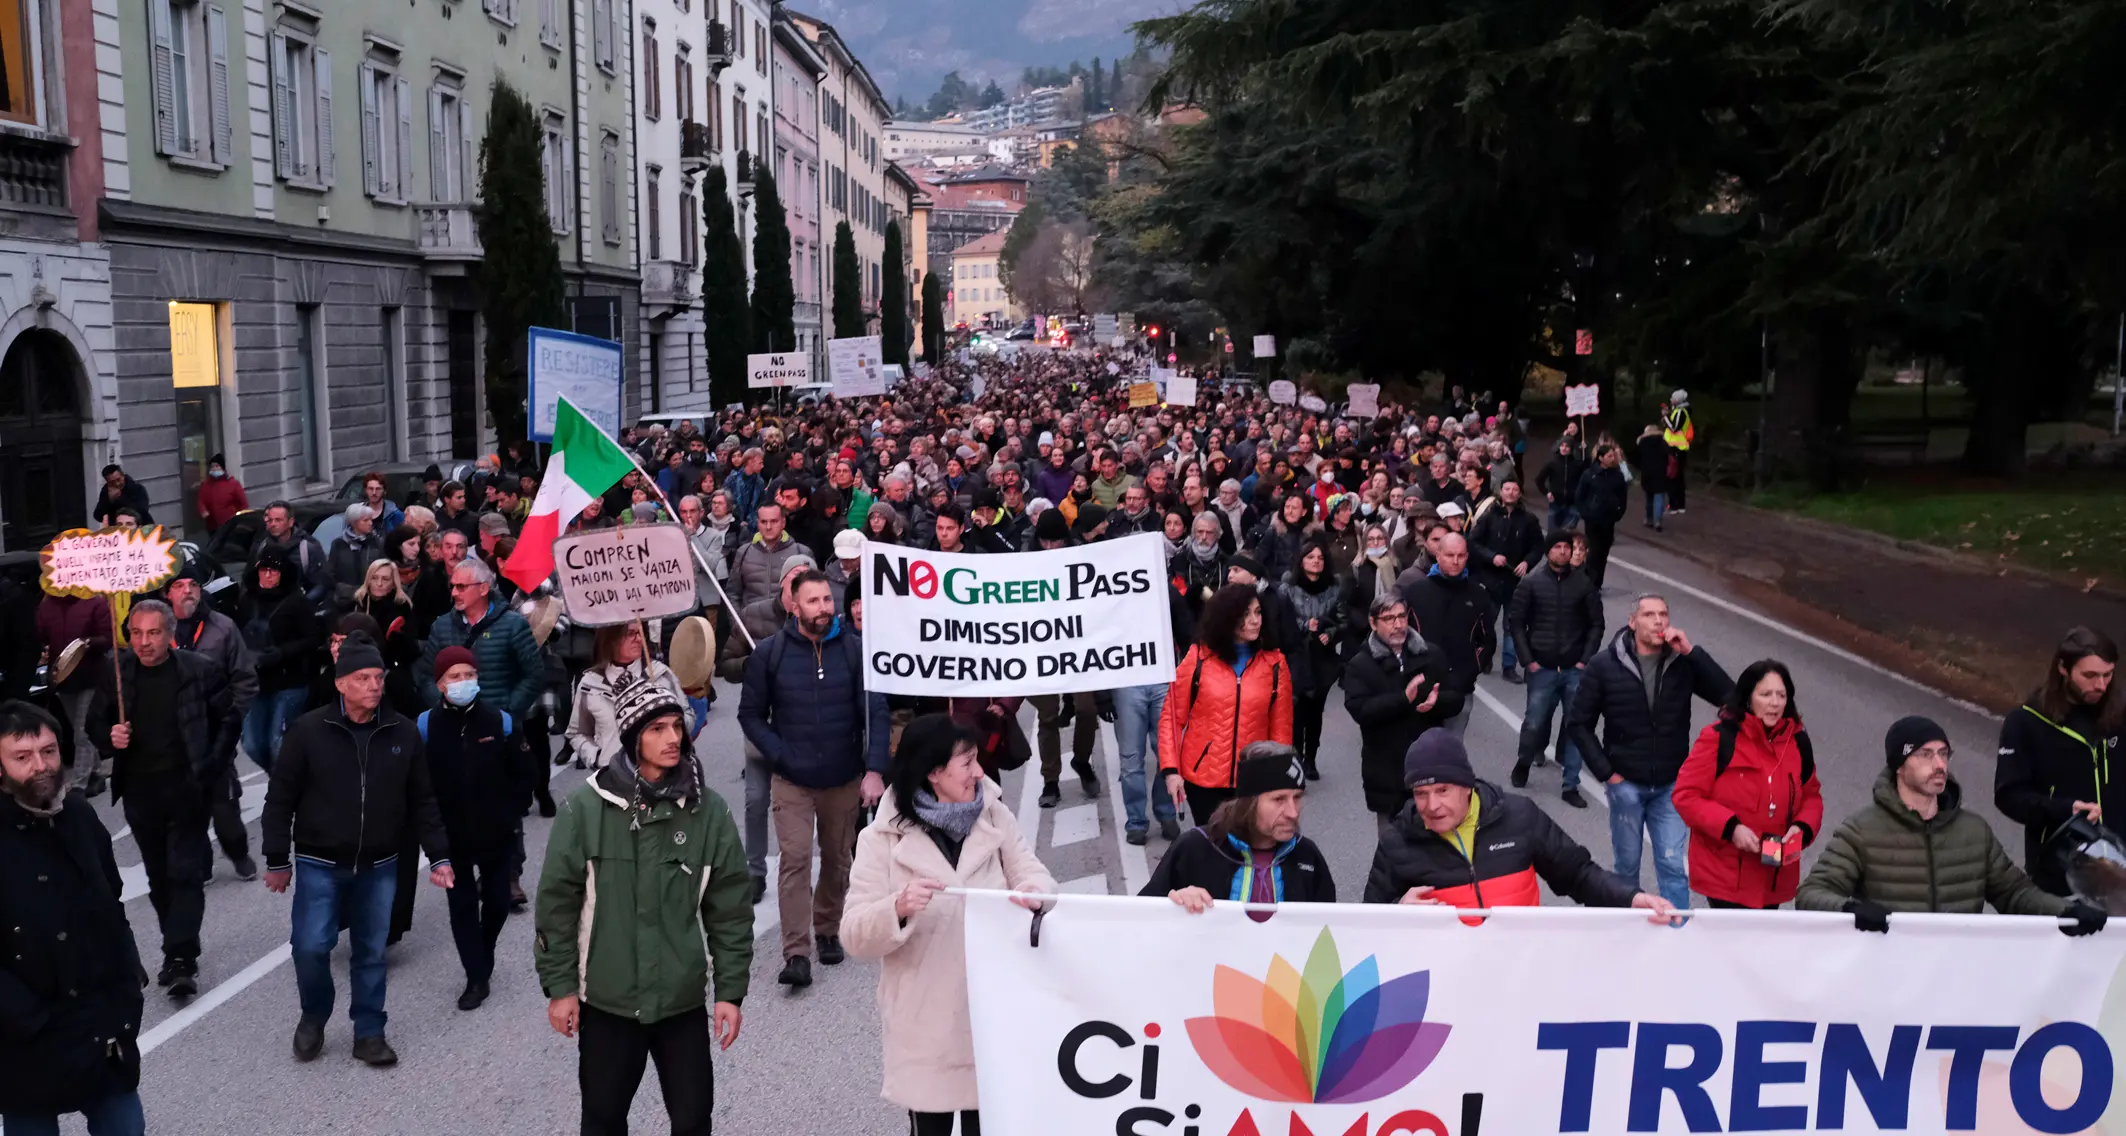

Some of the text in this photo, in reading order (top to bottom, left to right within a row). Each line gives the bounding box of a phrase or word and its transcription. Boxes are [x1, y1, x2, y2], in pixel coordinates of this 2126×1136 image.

[541, 346, 619, 380] RESISTERE
[755, 369, 806, 380] GREEN PASS
[771, 356, 785, 366] NO
[58, 535, 119, 550] IL GOVERNO
[128, 549, 145, 561] HA
[565, 537, 650, 570] COMPREN
[57, 563, 164, 584] AUMENTATO PURE IL
[620, 567, 635, 581] SE
[641, 558, 681, 579] VANZA
[584, 579, 691, 607] SOLDI DAI TAMPONI
[920, 615, 1083, 645] DIMISSIONI
[872, 641, 1157, 681] GOVERNO DRAGHI
[1057, 1020, 1162, 1100] Ci
[1536, 1020, 2114, 1135] TRENTO
